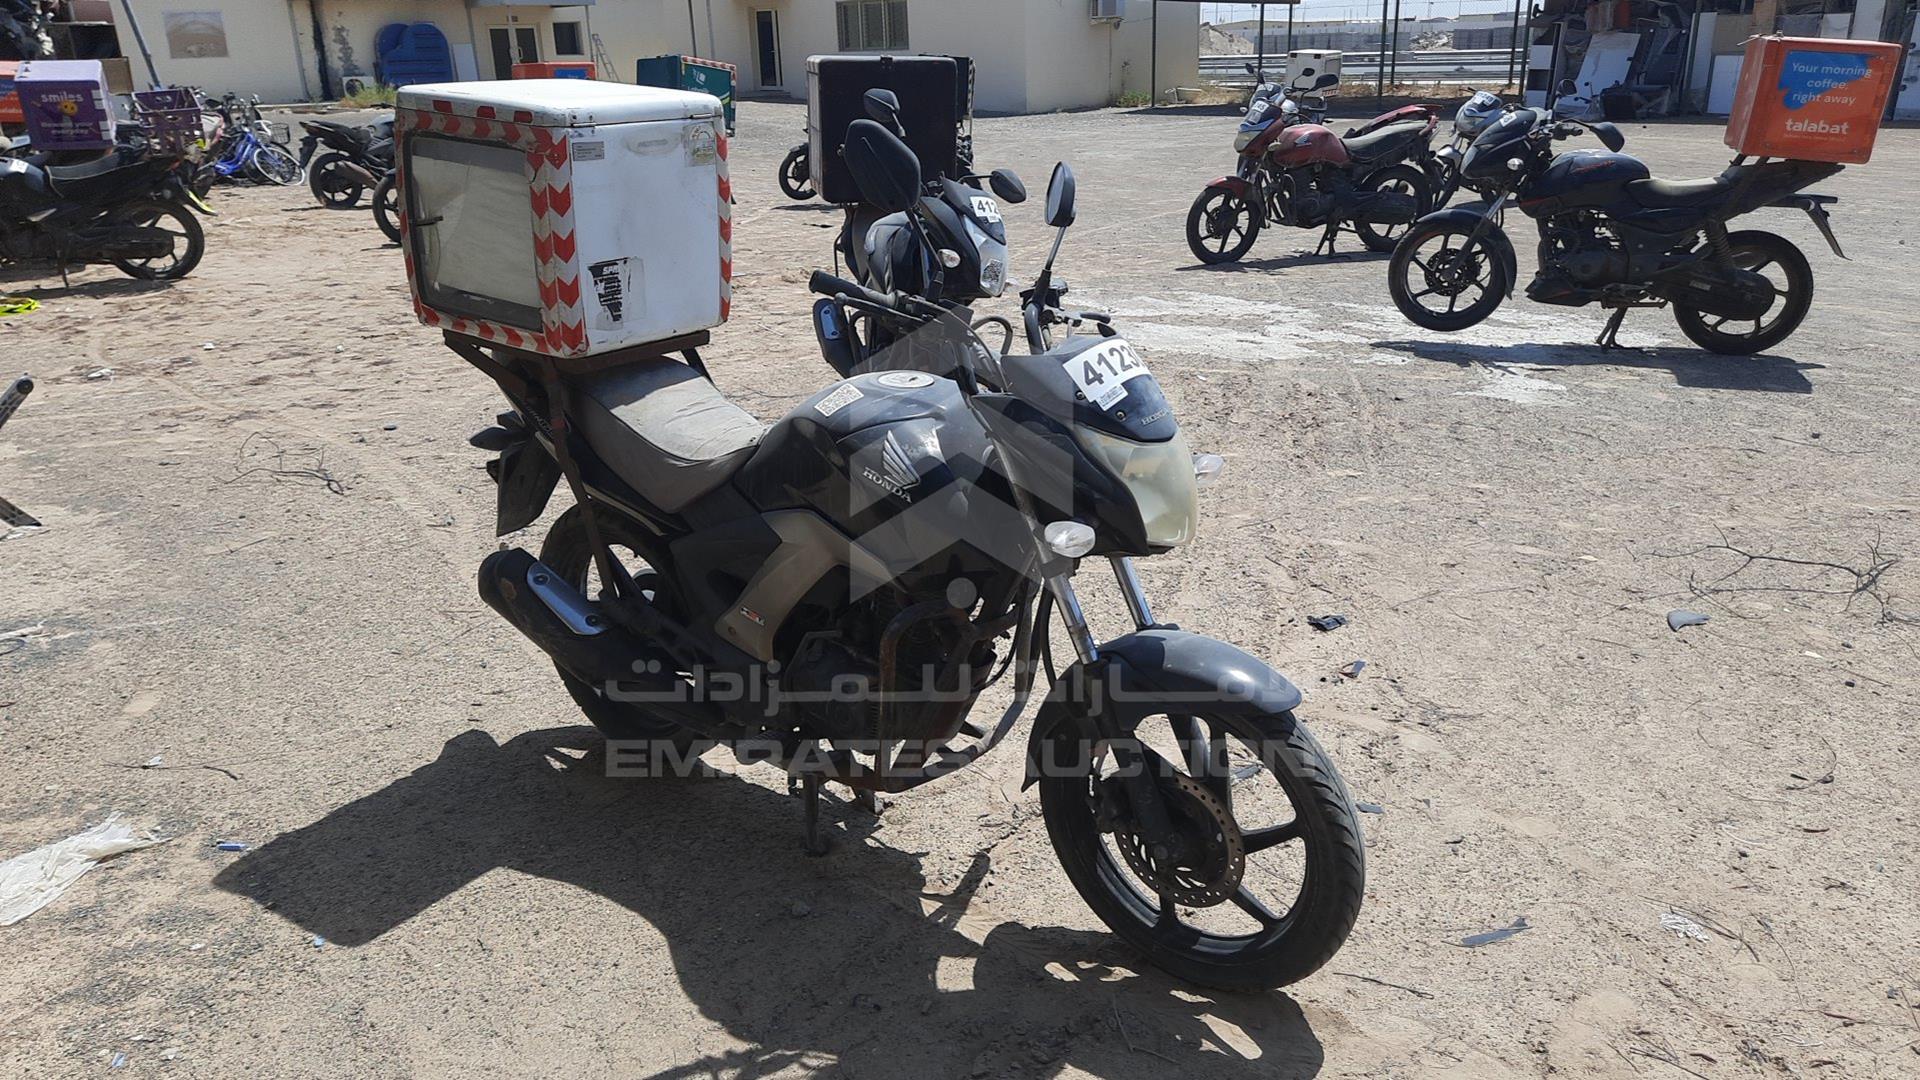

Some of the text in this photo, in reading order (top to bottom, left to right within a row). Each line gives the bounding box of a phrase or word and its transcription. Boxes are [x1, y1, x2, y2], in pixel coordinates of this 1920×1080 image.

[1792, 62, 1872, 78] Your morning
[41, 91, 84, 103] smiles
[1792, 91, 1856, 105] right away
[1785, 118, 1848, 134] talabat
[1082, 344, 1146, 386] 4123
[862, 466, 912, 503] HONDA
